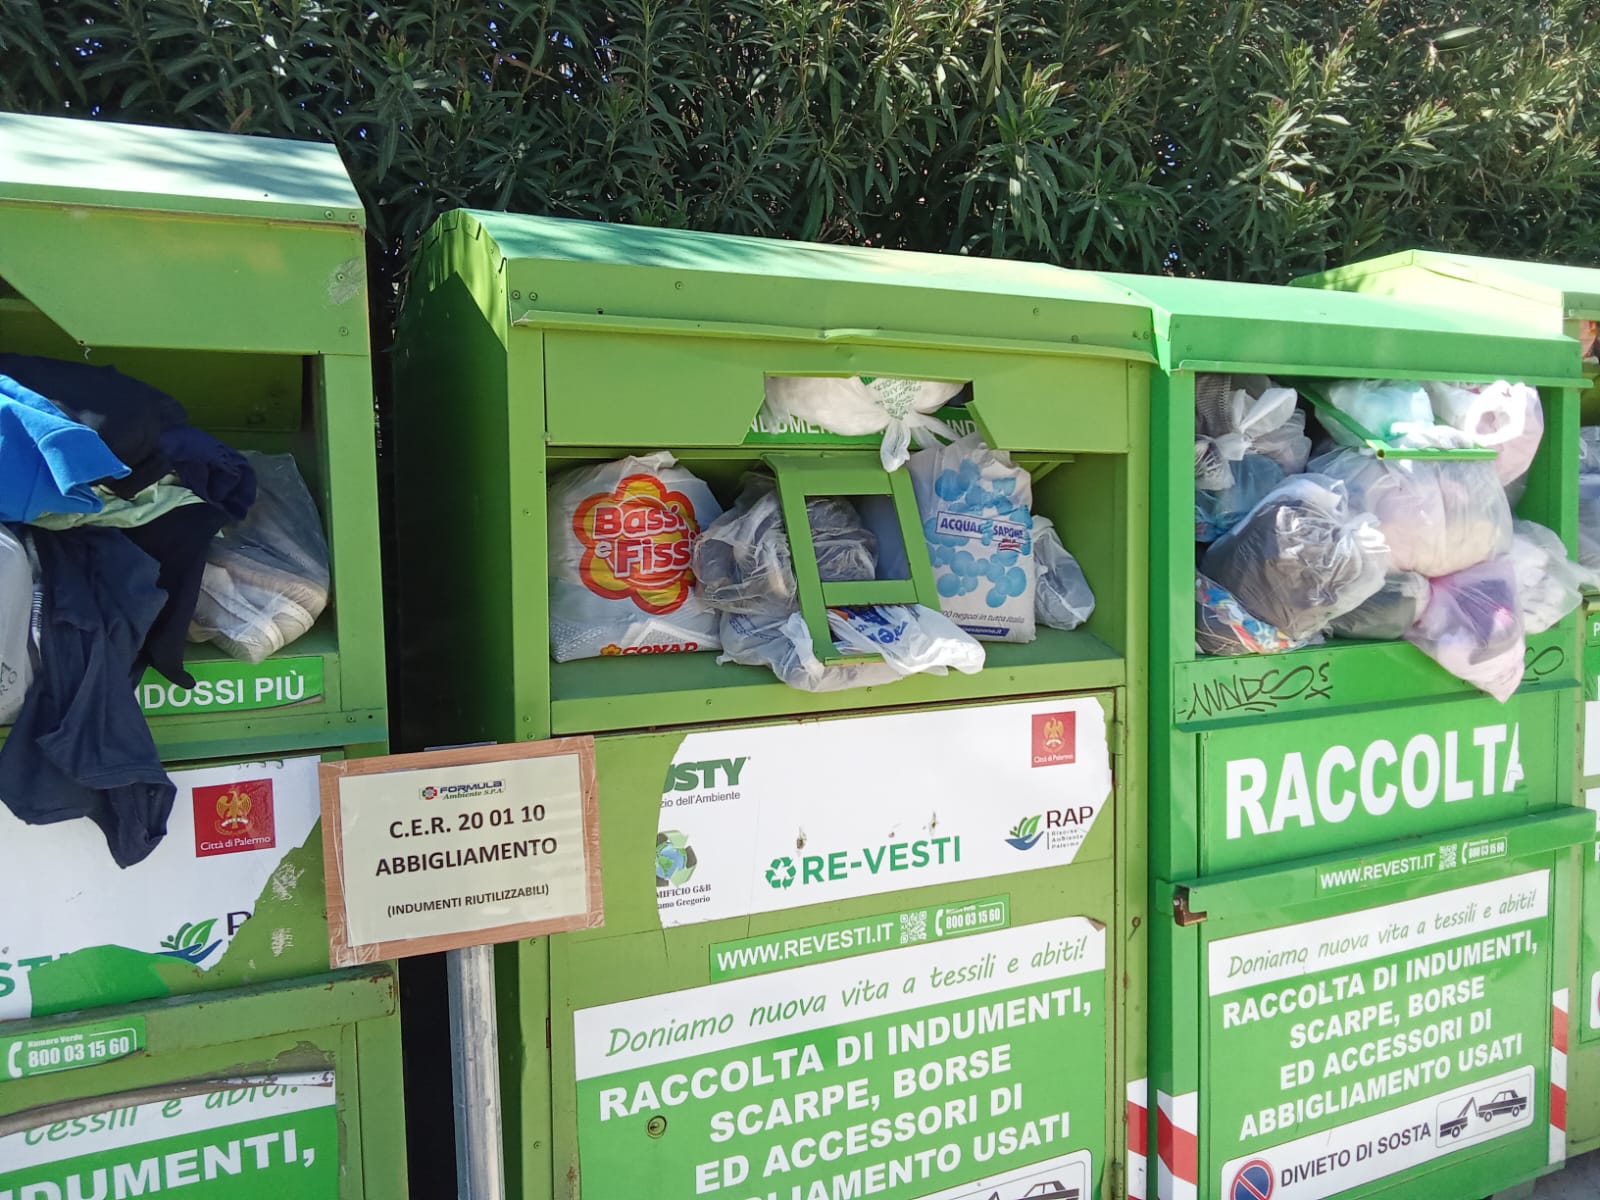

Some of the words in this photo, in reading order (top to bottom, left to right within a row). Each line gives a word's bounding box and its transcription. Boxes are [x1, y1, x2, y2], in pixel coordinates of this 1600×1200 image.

[593, 504, 686, 539] Bassi
[595, 540, 612, 559] e
[134, 679, 244, 709] DOSSI
[255, 669, 304, 702] PIÙ
[440, 780, 503, 794] FORMULA
[675, 791, 741, 807] dell'Ambiente
[389, 815, 451, 839] C.E.R.
[458, 811, 484, 832] 20
[489, 807, 515, 827] 01
[521, 804, 546, 824] 10
[1046, 805, 1095, 829] RAP
[200, 840, 224, 851] Città
[225, 839, 233, 848] di
[234, 836, 271, 847] Palermo
[375, 836, 558, 877] ABBIGLIAMENTO
[803, 836, 961, 885] RE-VESTI
[1320, 852, 1437, 889] WWW.REVESTI.IT
[387, 897, 462, 918] (INDUMENTI
[465, 883, 549, 906] RIUTILIZZABILI)
[676, 895, 711, 906] Gregorio
[946, 914, 964, 929] 800
[965, 912, 977, 926] 03
[978, 909, 988, 924] 15
[716, 922, 894, 972] WWW.REVESTI.IT
[1227, 946, 1308, 978] Doniamo
[1317, 933, 1368, 959] nuova
[1378, 922, 1409, 945] vita
[1416, 922, 1426, 935] a
[1434, 902, 1476, 930] tessili
[1482, 906, 1492, 919] e
[1499, 889, 1537, 917] abiti!
[605, 1013, 734, 1057] Doniamo
[749, 993, 828, 1027] nuova
[841, 980, 889, 1008] vita
[903, 976, 916, 994] a
[930, 953, 997, 989] tessili
[1007, 957, 1019, 973] e
[1031, 936, 1088, 968] abiti!
[1223, 973, 1366, 1029] RACCOLTA
[1373, 963, 1398, 992] DI
[1405, 929, 1538, 983] INDUMENTI,
[1289, 1001, 1401, 1049] SCARPE,
[1408, 975, 1485, 1019] BORSE
[28, 1047, 61, 1068] 800
[63, 1043, 85, 1062] 03
[88, 1040, 106, 1058] 15
[109, 1036, 130, 1056] 60
[599, 1043, 825, 1122] RACCOLTA
[837, 1031, 873, 1068] DI
[887, 986, 1092, 1056] INDUMENTI,
[1280, 1060, 1315, 1091] ED
[1322, 1017, 1463, 1079] ACCESSORI
[1470, 1007, 1493, 1035] DI
[709, 1077, 880, 1143] SCARPE,
[893, 1043, 1012, 1099] BORSE
[1238, 1054, 1451, 1142] ABBIGLIAMENTO
[1458, 1033, 1523, 1072] USATI
[696, 1154, 749, 1195] ED
[762, 1094, 977, 1178] ACCESSORI
[990, 1083, 1023, 1117] DI
[744, 1143, 961, 1200] AMENTO
[973, 1111, 1070, 1163] USATI
[1280, 1150, 1351, 1188] DIVIETO
[1356, 1143, 1372, 1160] DI
[1377, 1122, 1432, 1155] SOSTA
[0, 1129, 316, 1200] DUMENTI,
